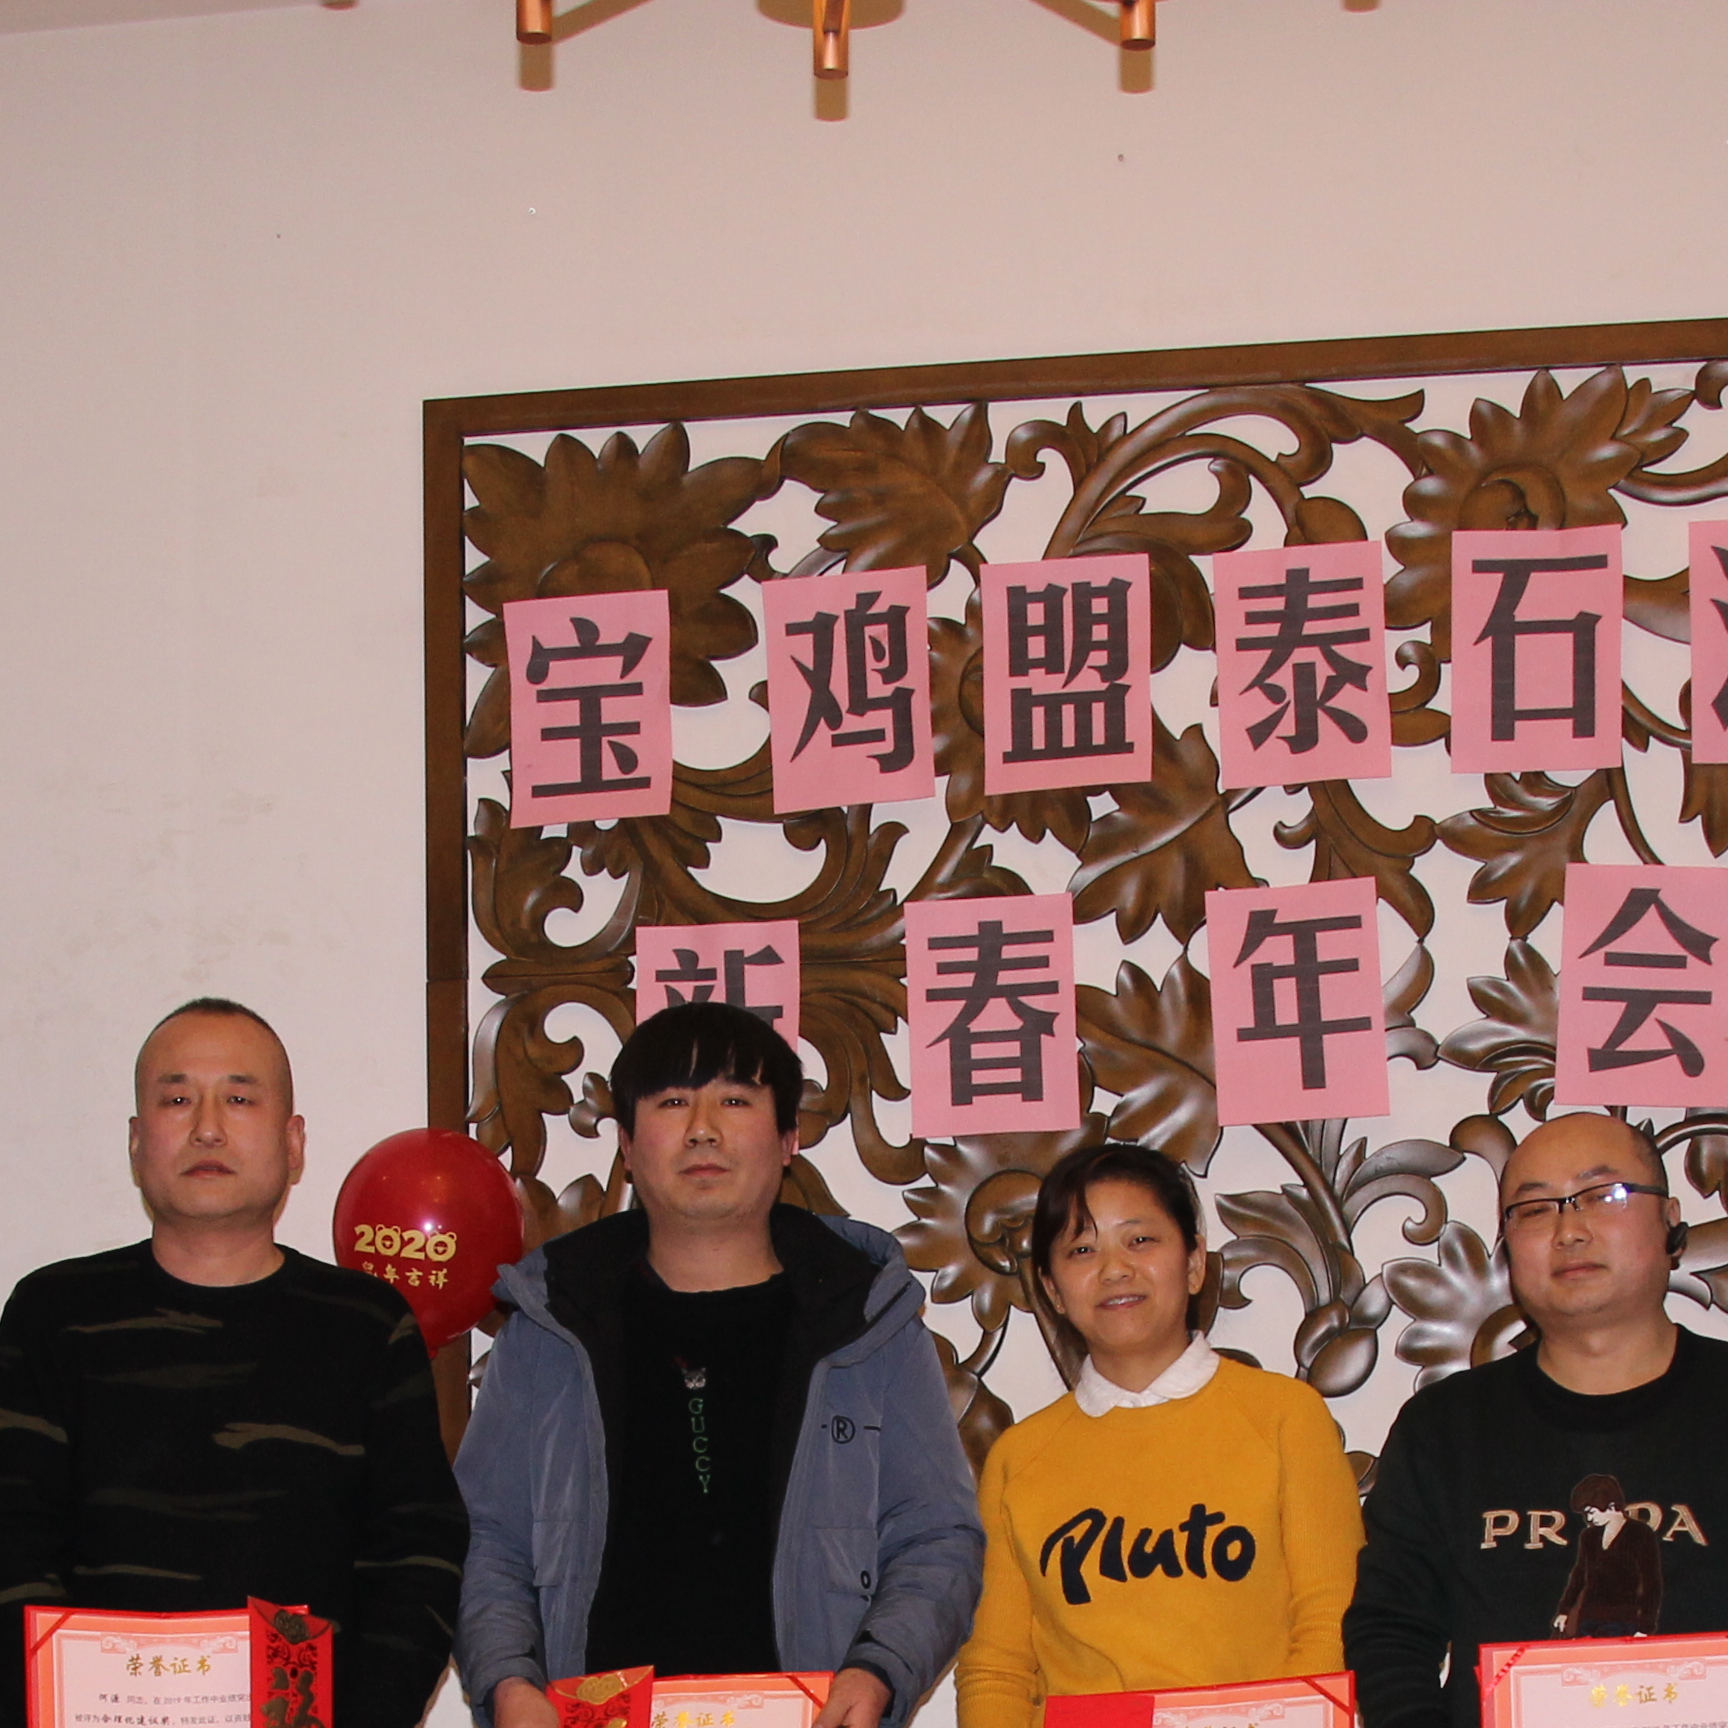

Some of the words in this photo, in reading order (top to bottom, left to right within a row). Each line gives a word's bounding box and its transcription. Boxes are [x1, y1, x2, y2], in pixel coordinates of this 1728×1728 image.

[354, 1224, 458, 1262] 2020
[688, 1398, 712, 1494] GUCCY
[1480, 1501, 1710, 1549] PRDA
[1039, 1503, 1256, 1605] Pluto
[126, 1654, 212, 1677] 荣誉证书
[1589, 1682, 1680, 1708] 荣誉证书
